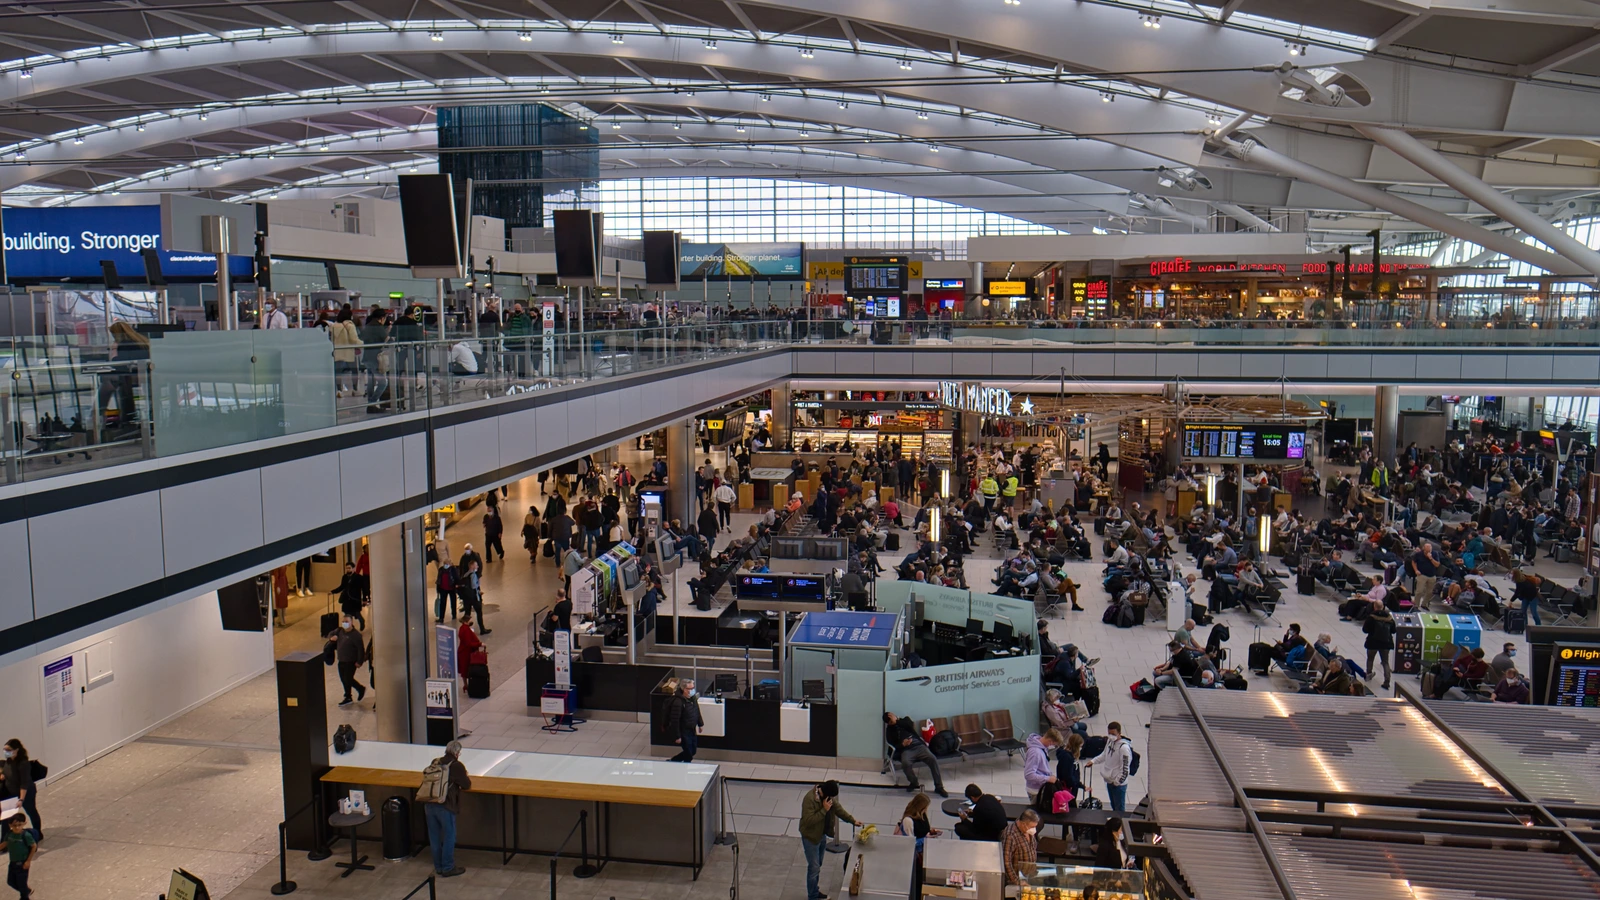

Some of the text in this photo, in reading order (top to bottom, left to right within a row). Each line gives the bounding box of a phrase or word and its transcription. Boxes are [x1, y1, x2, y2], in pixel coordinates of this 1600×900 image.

[3, 231, 159, 253] building. Stronger
[1150, 257, 1286, 276] GIRAFFE WORLD KITCHEN
[1302, 263, 1326, 273] FOOD
[1335, 263, 1355, 273] ROM
[1357, 263, 1391, 273] AROND
[959, 383, 964, 410] A
[967, 384, 1012, 416] MANGER
[1574, 650, 1600, 660] Fligh
[935, 668, 1005, 683] BRITISH AIRWAYS
[935, 683, 969, 693] Customer
[971, 679, 1000, 689] Services
[1007, 675, 1032, 685] Central
